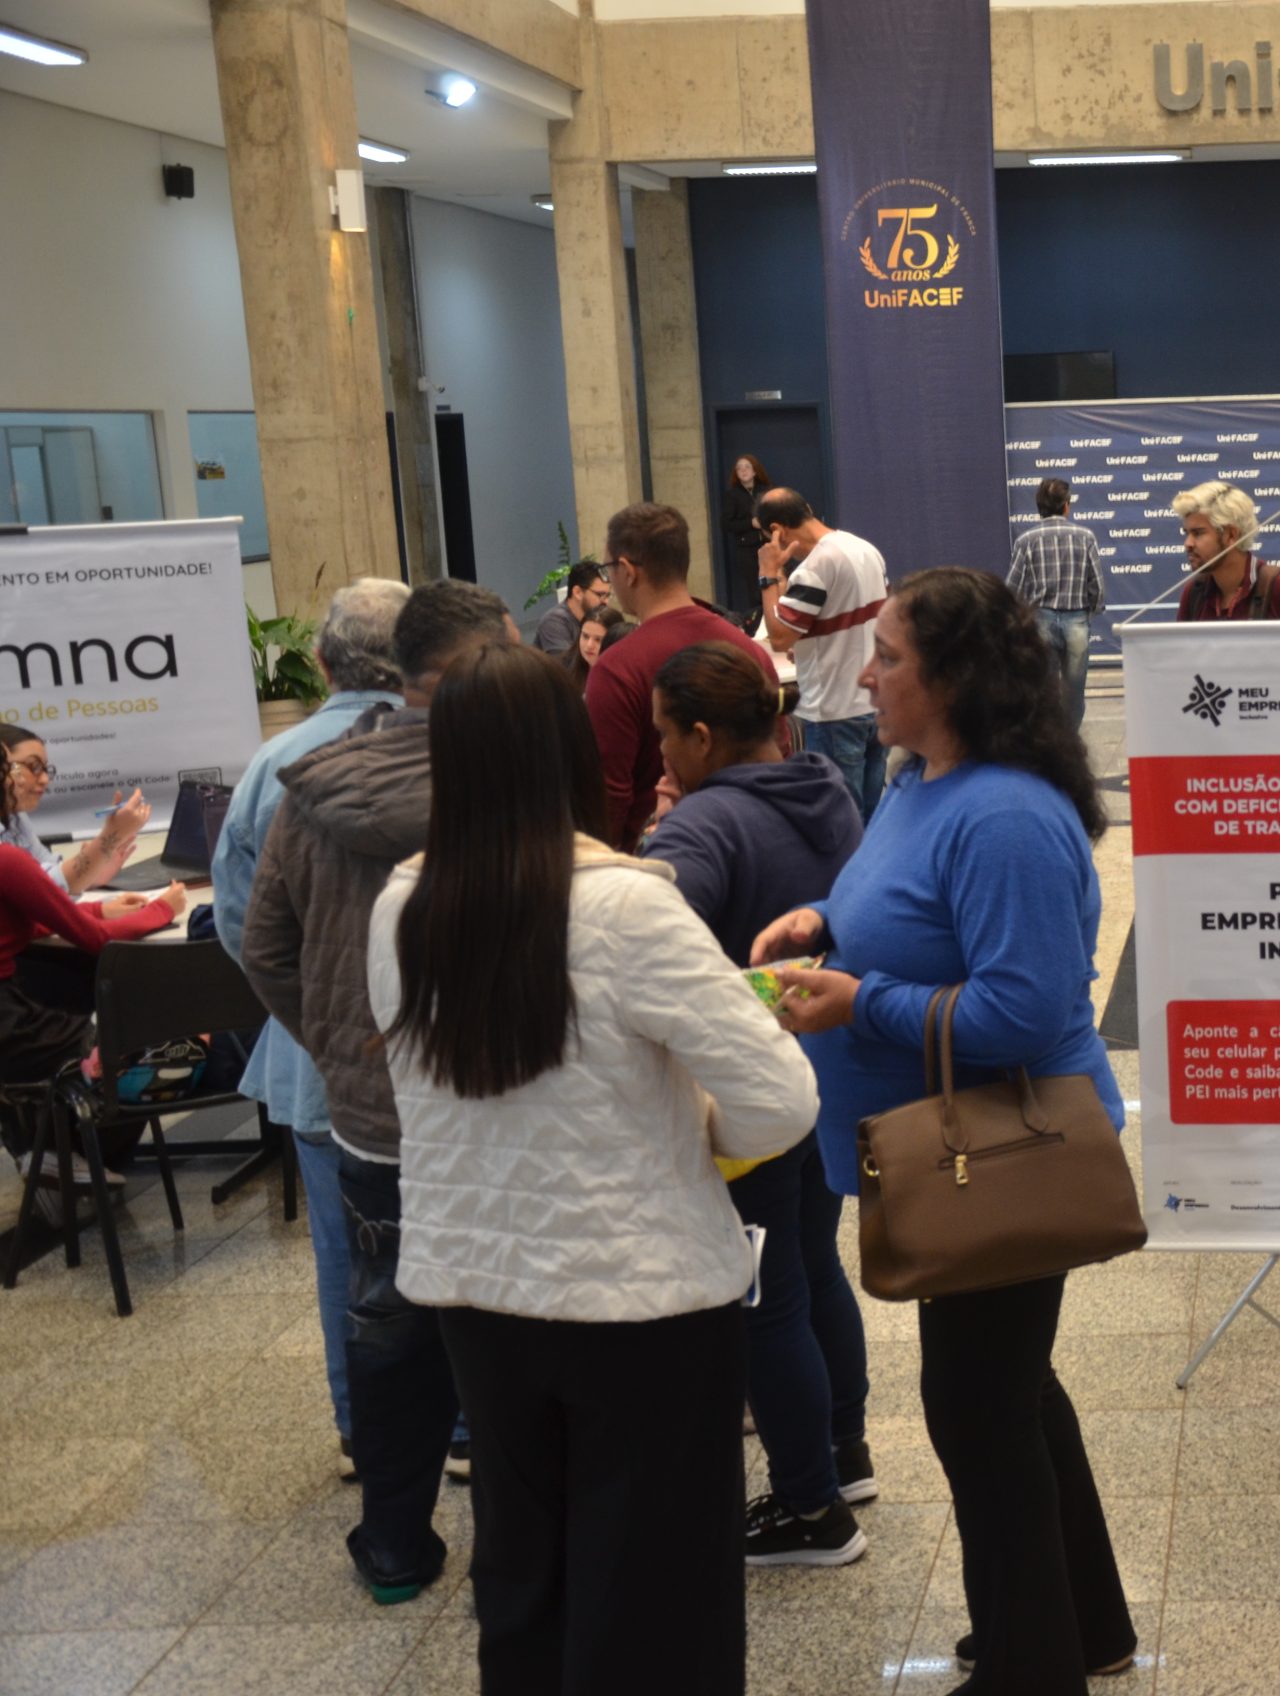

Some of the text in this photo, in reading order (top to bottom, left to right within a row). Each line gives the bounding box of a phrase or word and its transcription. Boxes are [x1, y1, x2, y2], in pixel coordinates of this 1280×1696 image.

[909, 178, 949, 197] MUNICIPAL
[878, 203, 939, 269] 75
[891, 269, 931, 282] anos
[864, 288, 963, 308] UniFACEF
[0, 563, 212, 586] NTO EM OPORTUNIDADE!
[1238, 688, 1269, 698] MEU
[29, 702, 58, 722] de
[67, 697, 158, 718] Pessoas
[49, 732, 117, 744] oportunidades!
[70, 781, 114, 792] escaneie
[127, 777, 142, 788] QR
[1174, 800, 1218, 815] COM
[1214, 820, 1240, 836] DE
[1183, 1024, 1238, 1040] Aponte
[1250, 1027, 1258, 1038] a
[1184, 1047, 1209, 1058] seu
[1217, 1044, 1267, 1058] celular
[1184, 1065, 1223, 1078] Code
[1230, 1067, 1239, 1078] e
[1186, 1085, 1209, 1099] PEI
[1214, 1085, 1248, 1099] mais
